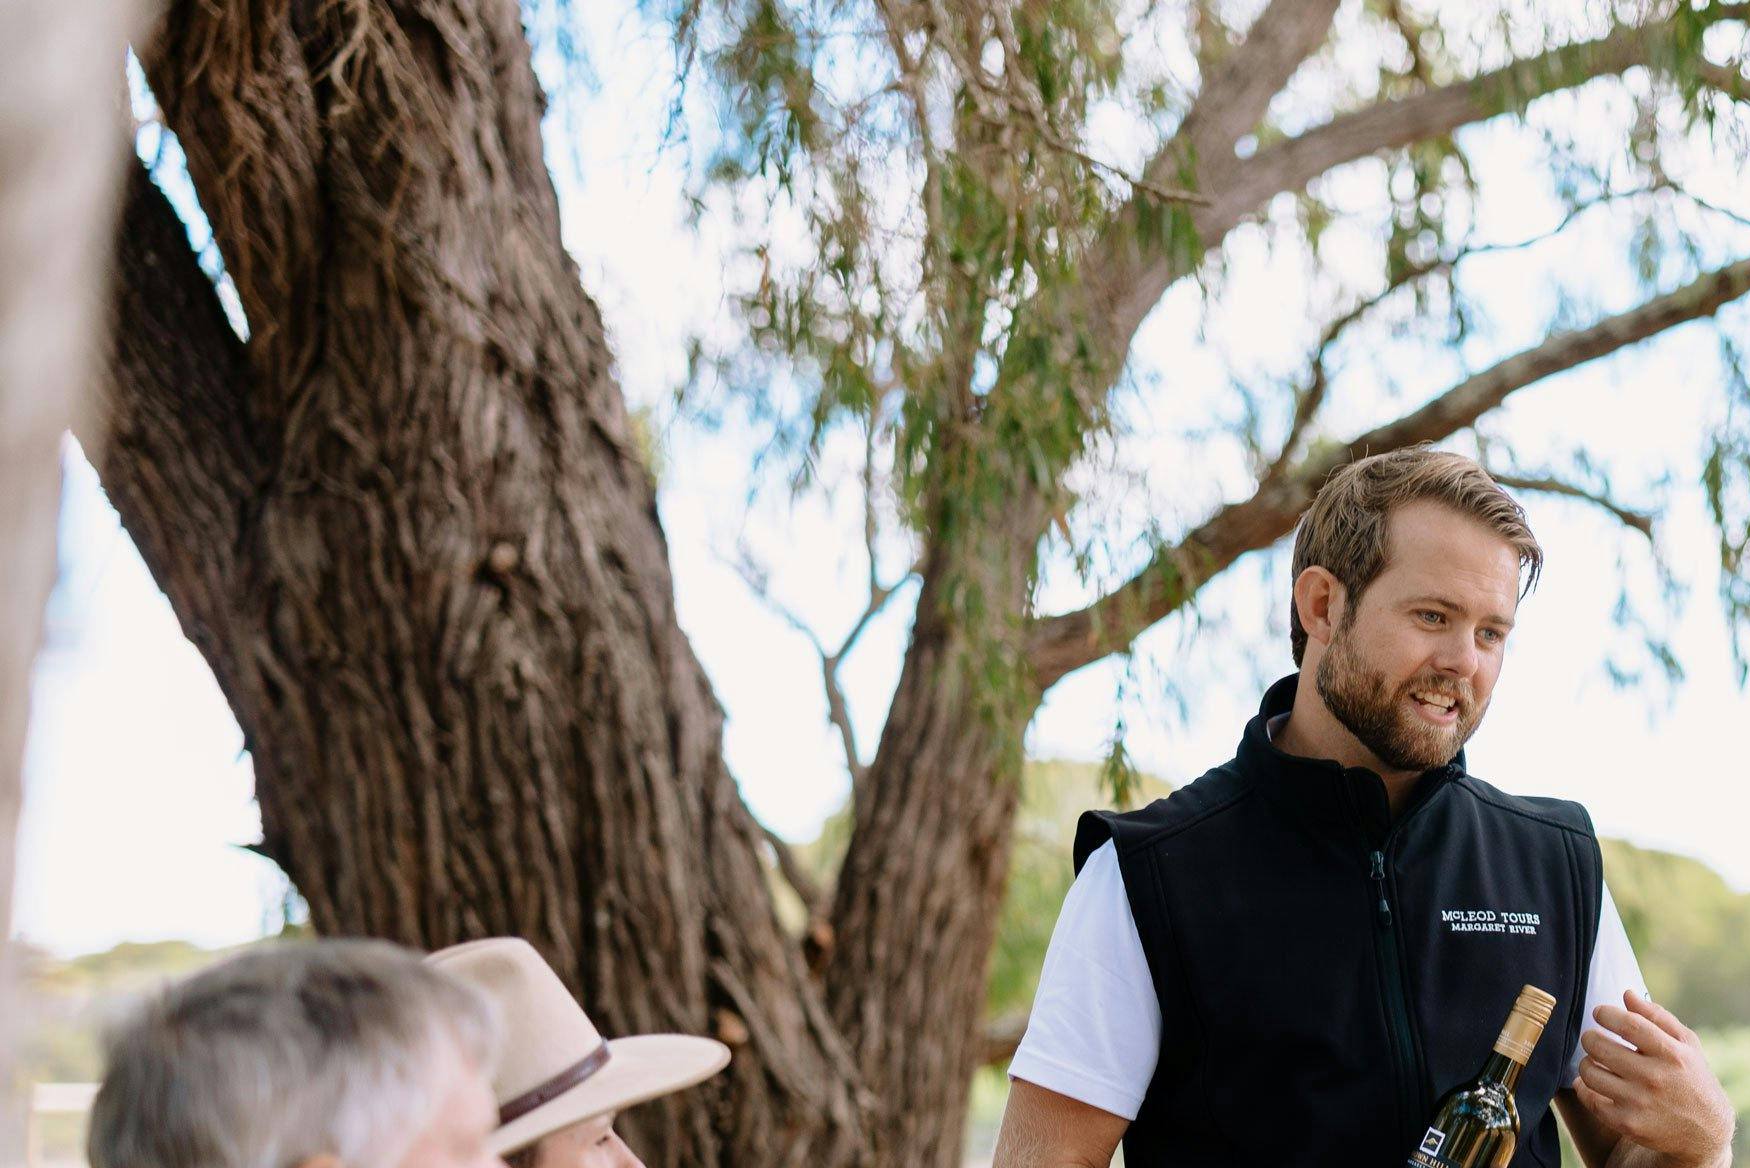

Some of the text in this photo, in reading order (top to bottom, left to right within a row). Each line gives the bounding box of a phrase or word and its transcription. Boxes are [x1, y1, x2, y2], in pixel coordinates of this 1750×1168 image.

[1501, 912, 1541, 925] TOURS
[1451, 922, 1537, 935] MARGARET RIVER
